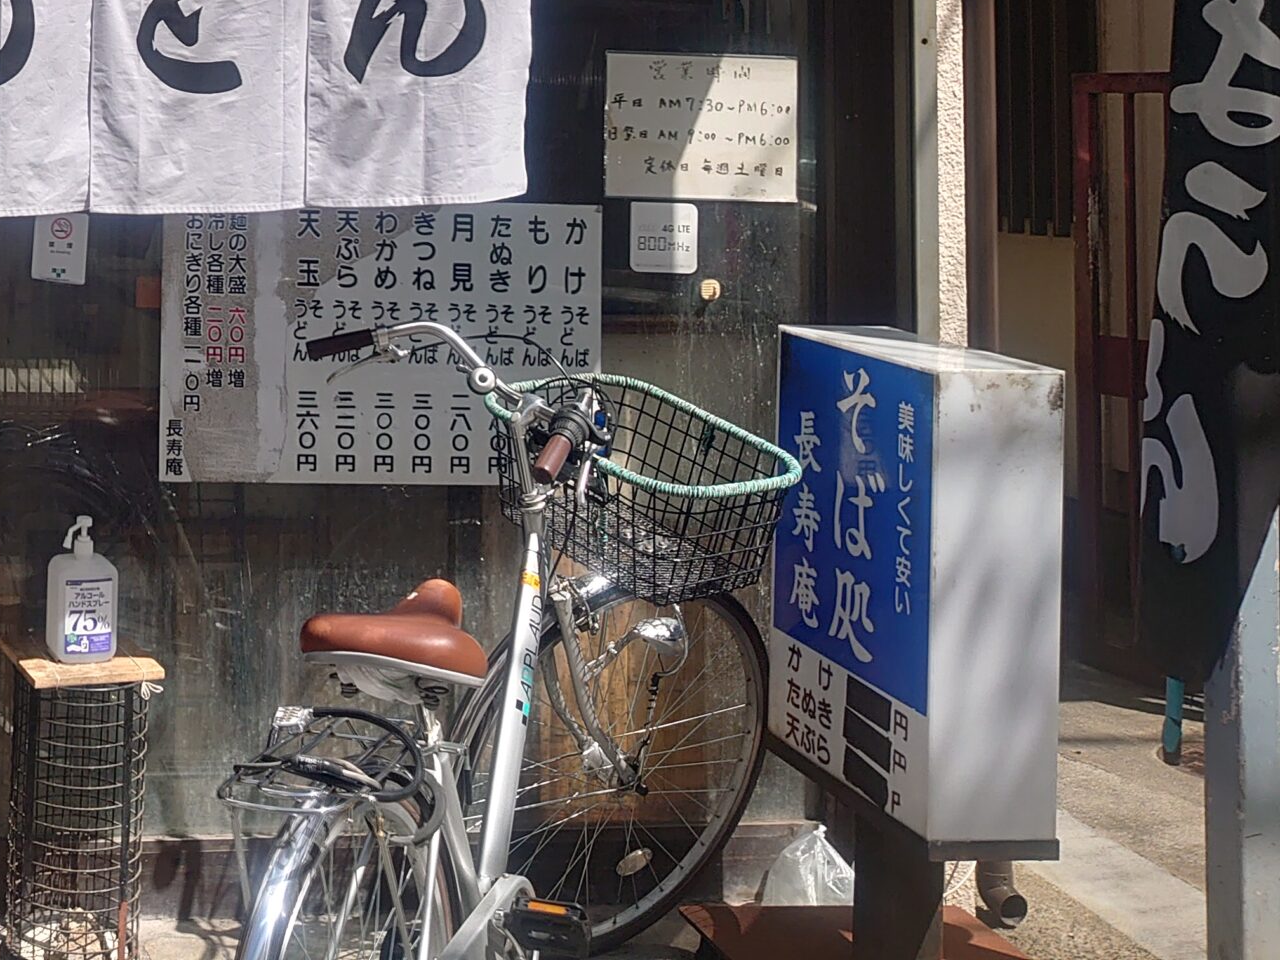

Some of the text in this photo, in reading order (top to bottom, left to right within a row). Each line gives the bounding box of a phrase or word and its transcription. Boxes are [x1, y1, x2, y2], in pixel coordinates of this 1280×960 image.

[610, 93, 643, 112] 平日
[644, 155, 689, 176] 定休日
[297, 210, 320, 287] 天玉
[336, 210, 359, 288] 天ぷら
[374, 211, 397, 290] わかめ
[412, 212, 436, 291] きつね
[450, 213, 473, 292] 月見
[489, 214, 512, 293] たぬき
[528, 215, 549, 294] もり
[565, 217, 587, 295] かけ
[661, 224, 691, 234] 4G LTE
[184, 214, 203, 337] おにぎり各種
[165, 419, 183, 476] 長寿庵
[296, 390, 320, 472] 三六〇円
[373, 392, 395, 474] 三〇〇円
[412, 392, 433, 474] 三〇〇円
[450, 394, 472, 474] 二八〇円
[789, 410, 822, 630] 長寿庵
[828, 367, 885, 664] そば処
[894, 400, 915, 616] 美味しくて安い
[68, 600, 110, 608] ハンドスプレー
[68, 609, 110, 632] 75%
[74, 592, 105, 600] アルコール
[521, 594, 544, 702] APPLAUD
[787, 644, 833, 691] かけ
[785, 712, 831, 765] 天ぷら
[786, 677, 833, 730] たぬき
